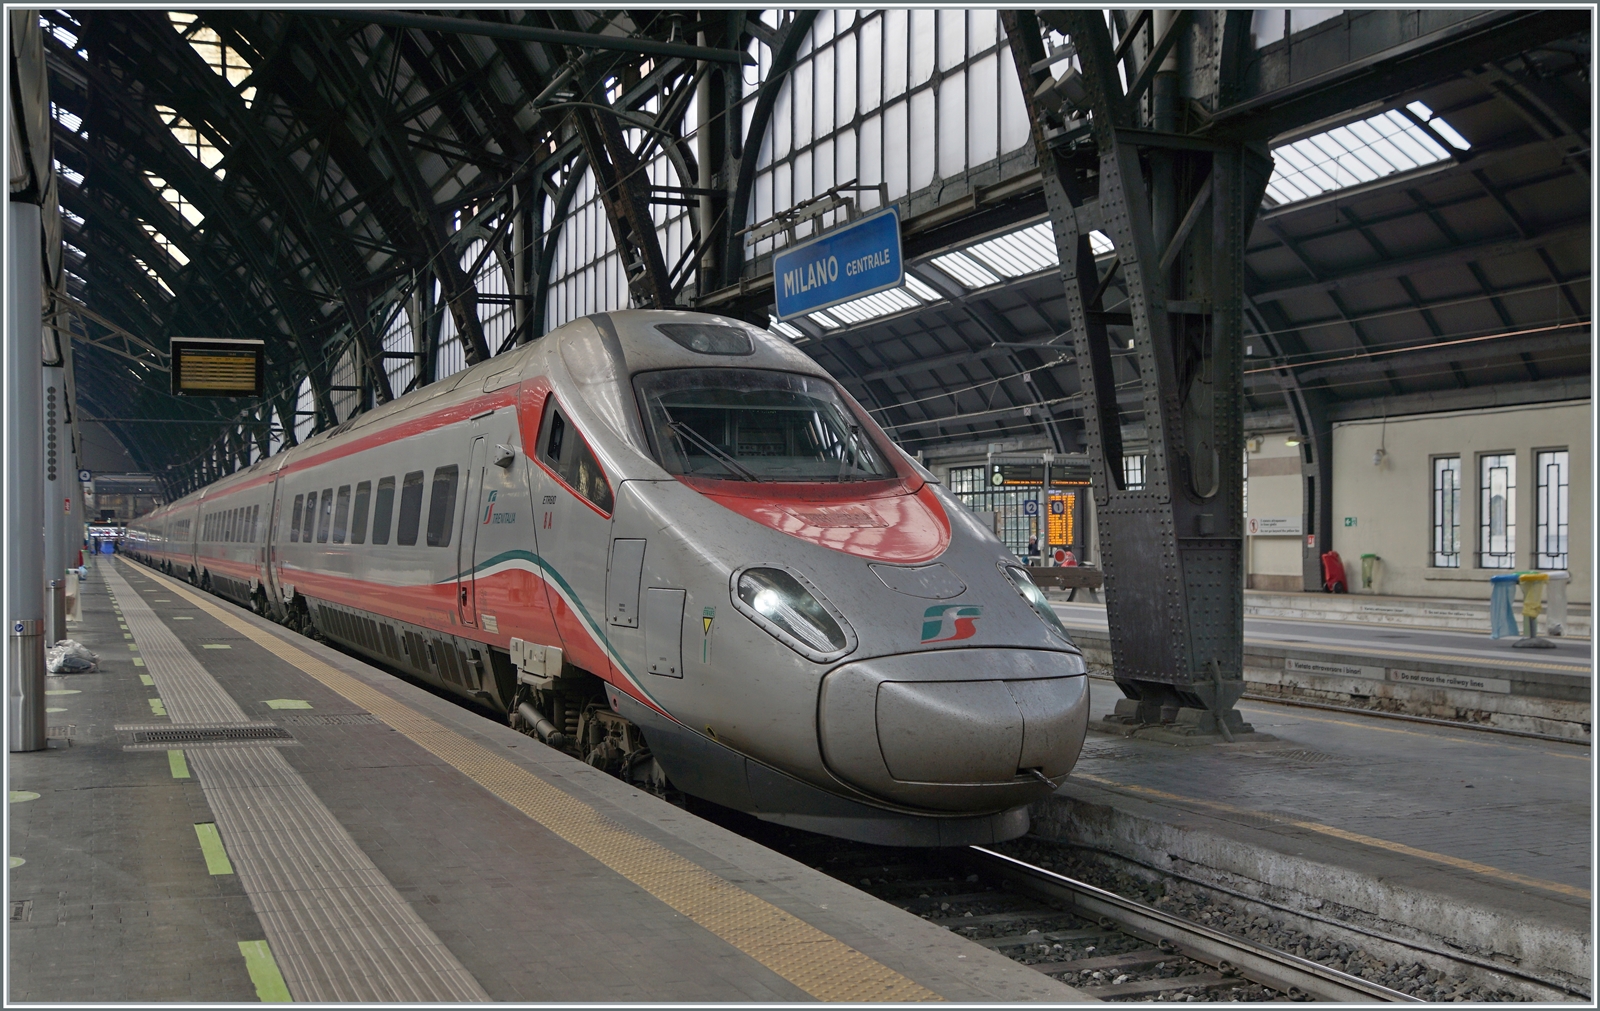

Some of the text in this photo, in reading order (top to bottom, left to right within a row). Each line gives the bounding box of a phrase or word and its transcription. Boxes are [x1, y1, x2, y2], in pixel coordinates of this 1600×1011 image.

[783, 248, 891, 298] MILANO CENTRALE
[1028, 503, 1034, 511] 2
[492, 512, 516, 524] TRENITALIA
[1294, 661, 1311, 670] Vietato
[1346, 667, 1362, 675] binari
[1401, 672, 1410, 680] Do
[1410, 673, 1420, 681] not
[1435, 676, 1445, 684] the
[1446, 677, 1469, 687] railway
[1470, 679, 1484, 688] lines
